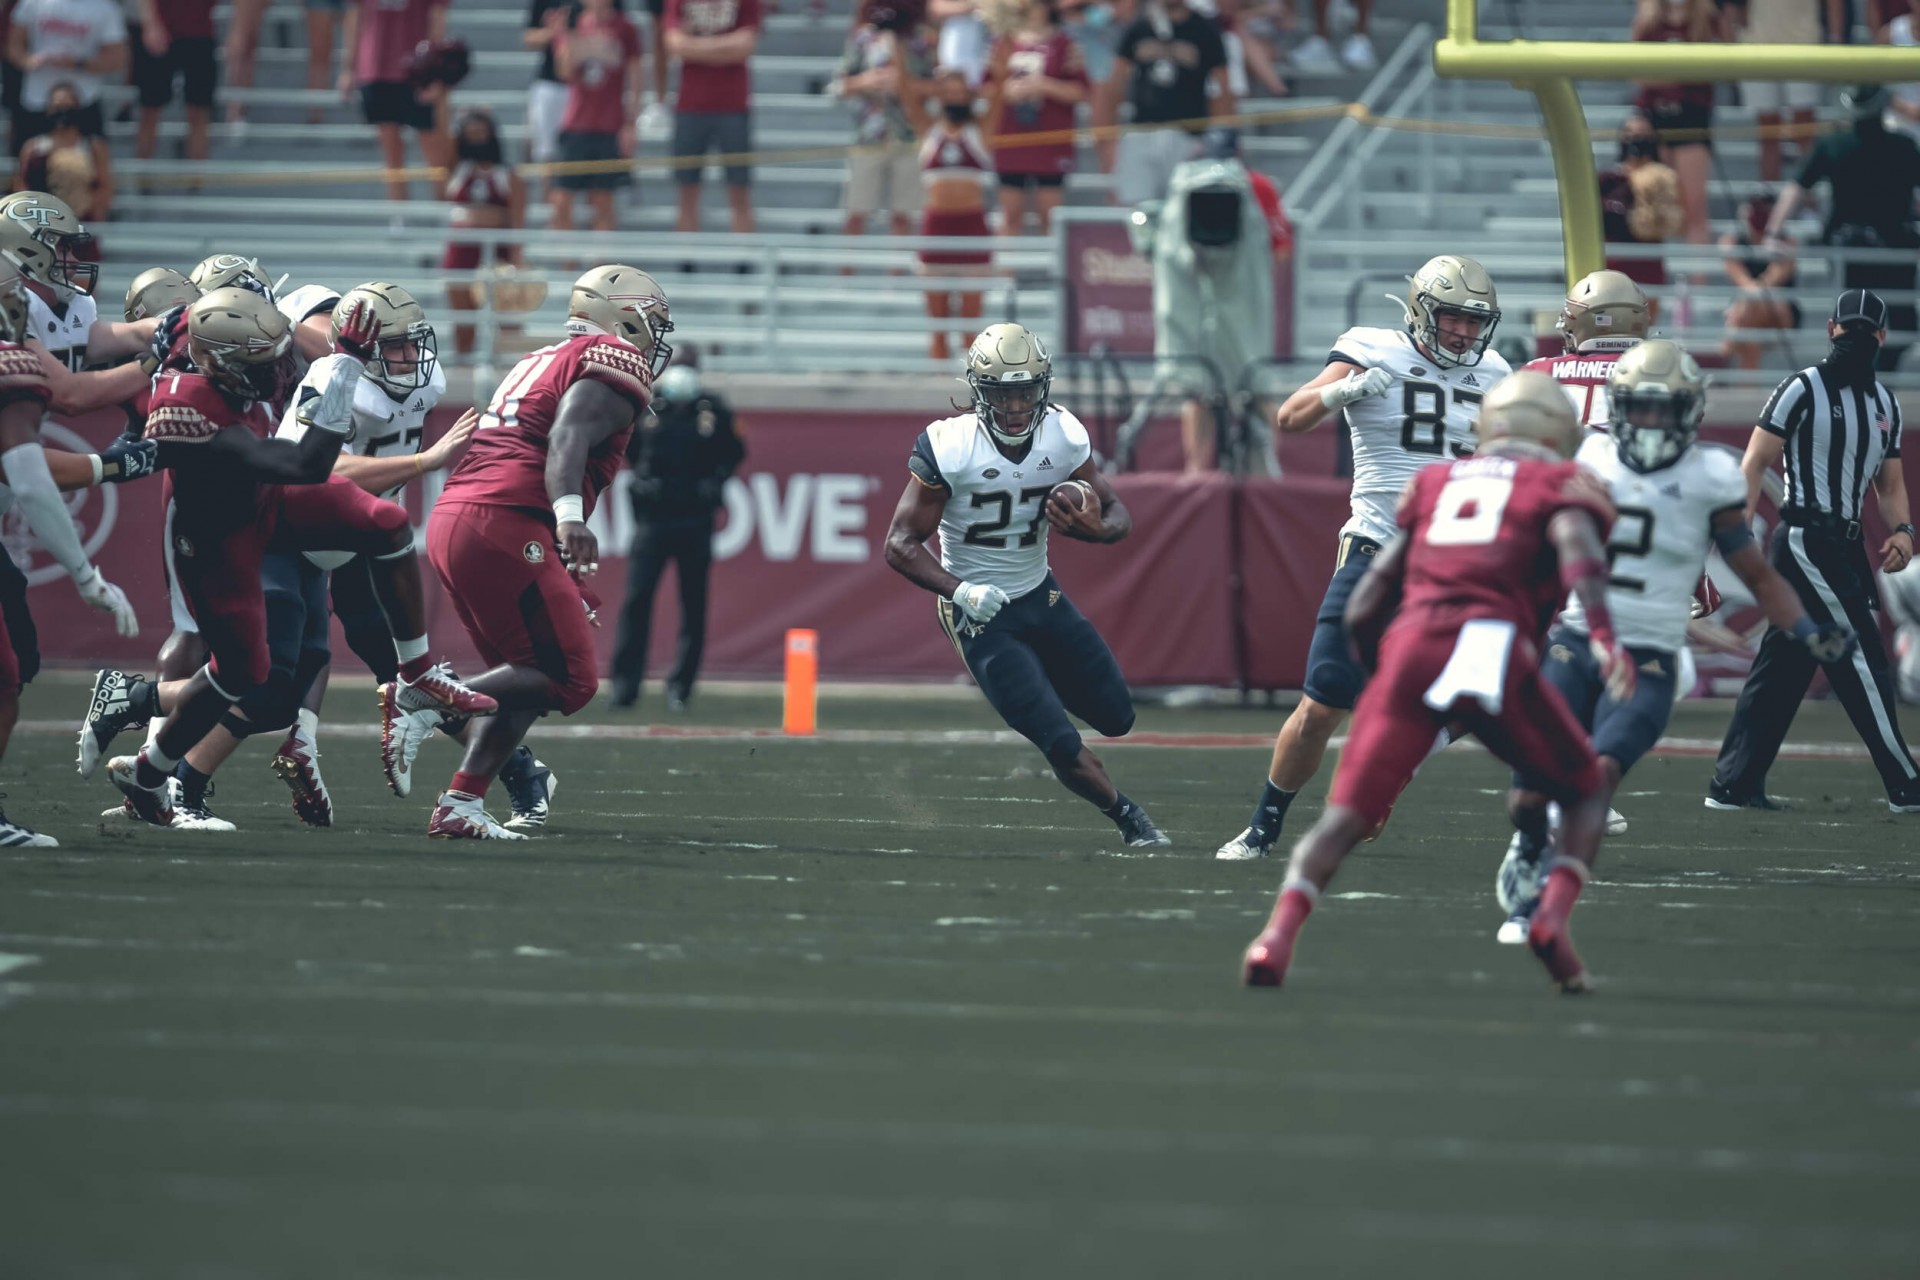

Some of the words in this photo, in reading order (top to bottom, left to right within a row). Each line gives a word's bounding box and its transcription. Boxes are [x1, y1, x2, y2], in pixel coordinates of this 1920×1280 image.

[7, 199, 59, 226] GT
[1551, 360, 1617, 378] WARNER
[1833, 405, 1842, 418] S
[963, 485, 1055, 548] 27
[1605, 505, 1655, 592] 2
[89, 670, 123, 723] adidas
